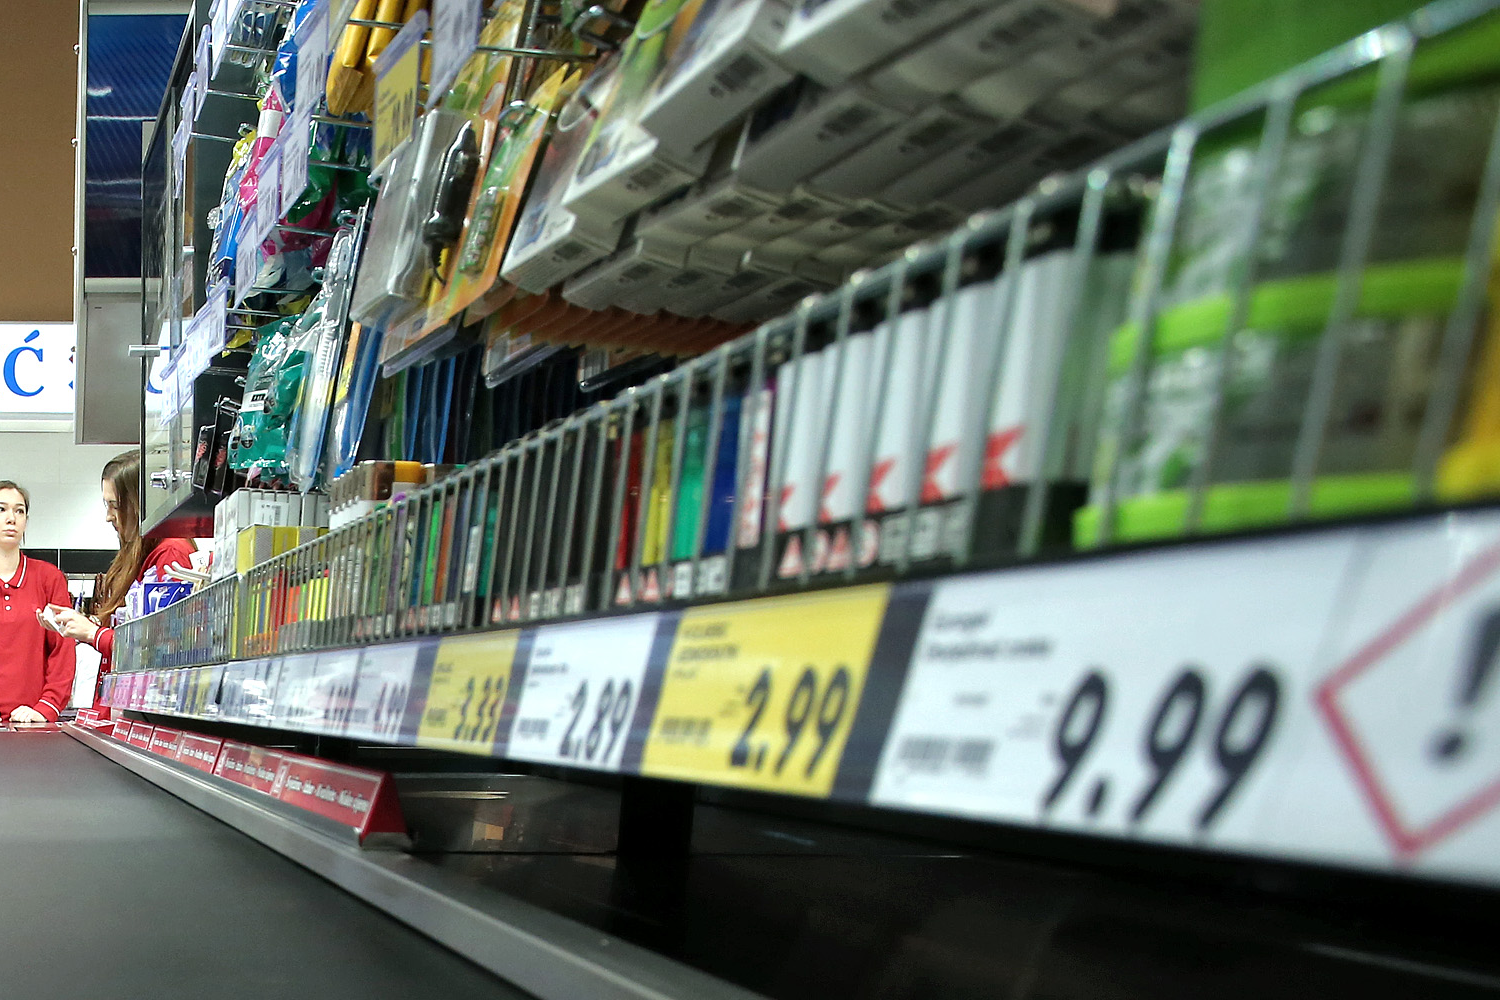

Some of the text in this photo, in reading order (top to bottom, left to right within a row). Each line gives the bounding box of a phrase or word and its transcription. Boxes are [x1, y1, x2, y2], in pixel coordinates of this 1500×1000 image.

[558, 676, 633, 763] 2.89
[730, 665, 851, 779] 2.99
[1038, 666, 1282, 829] 9.99
